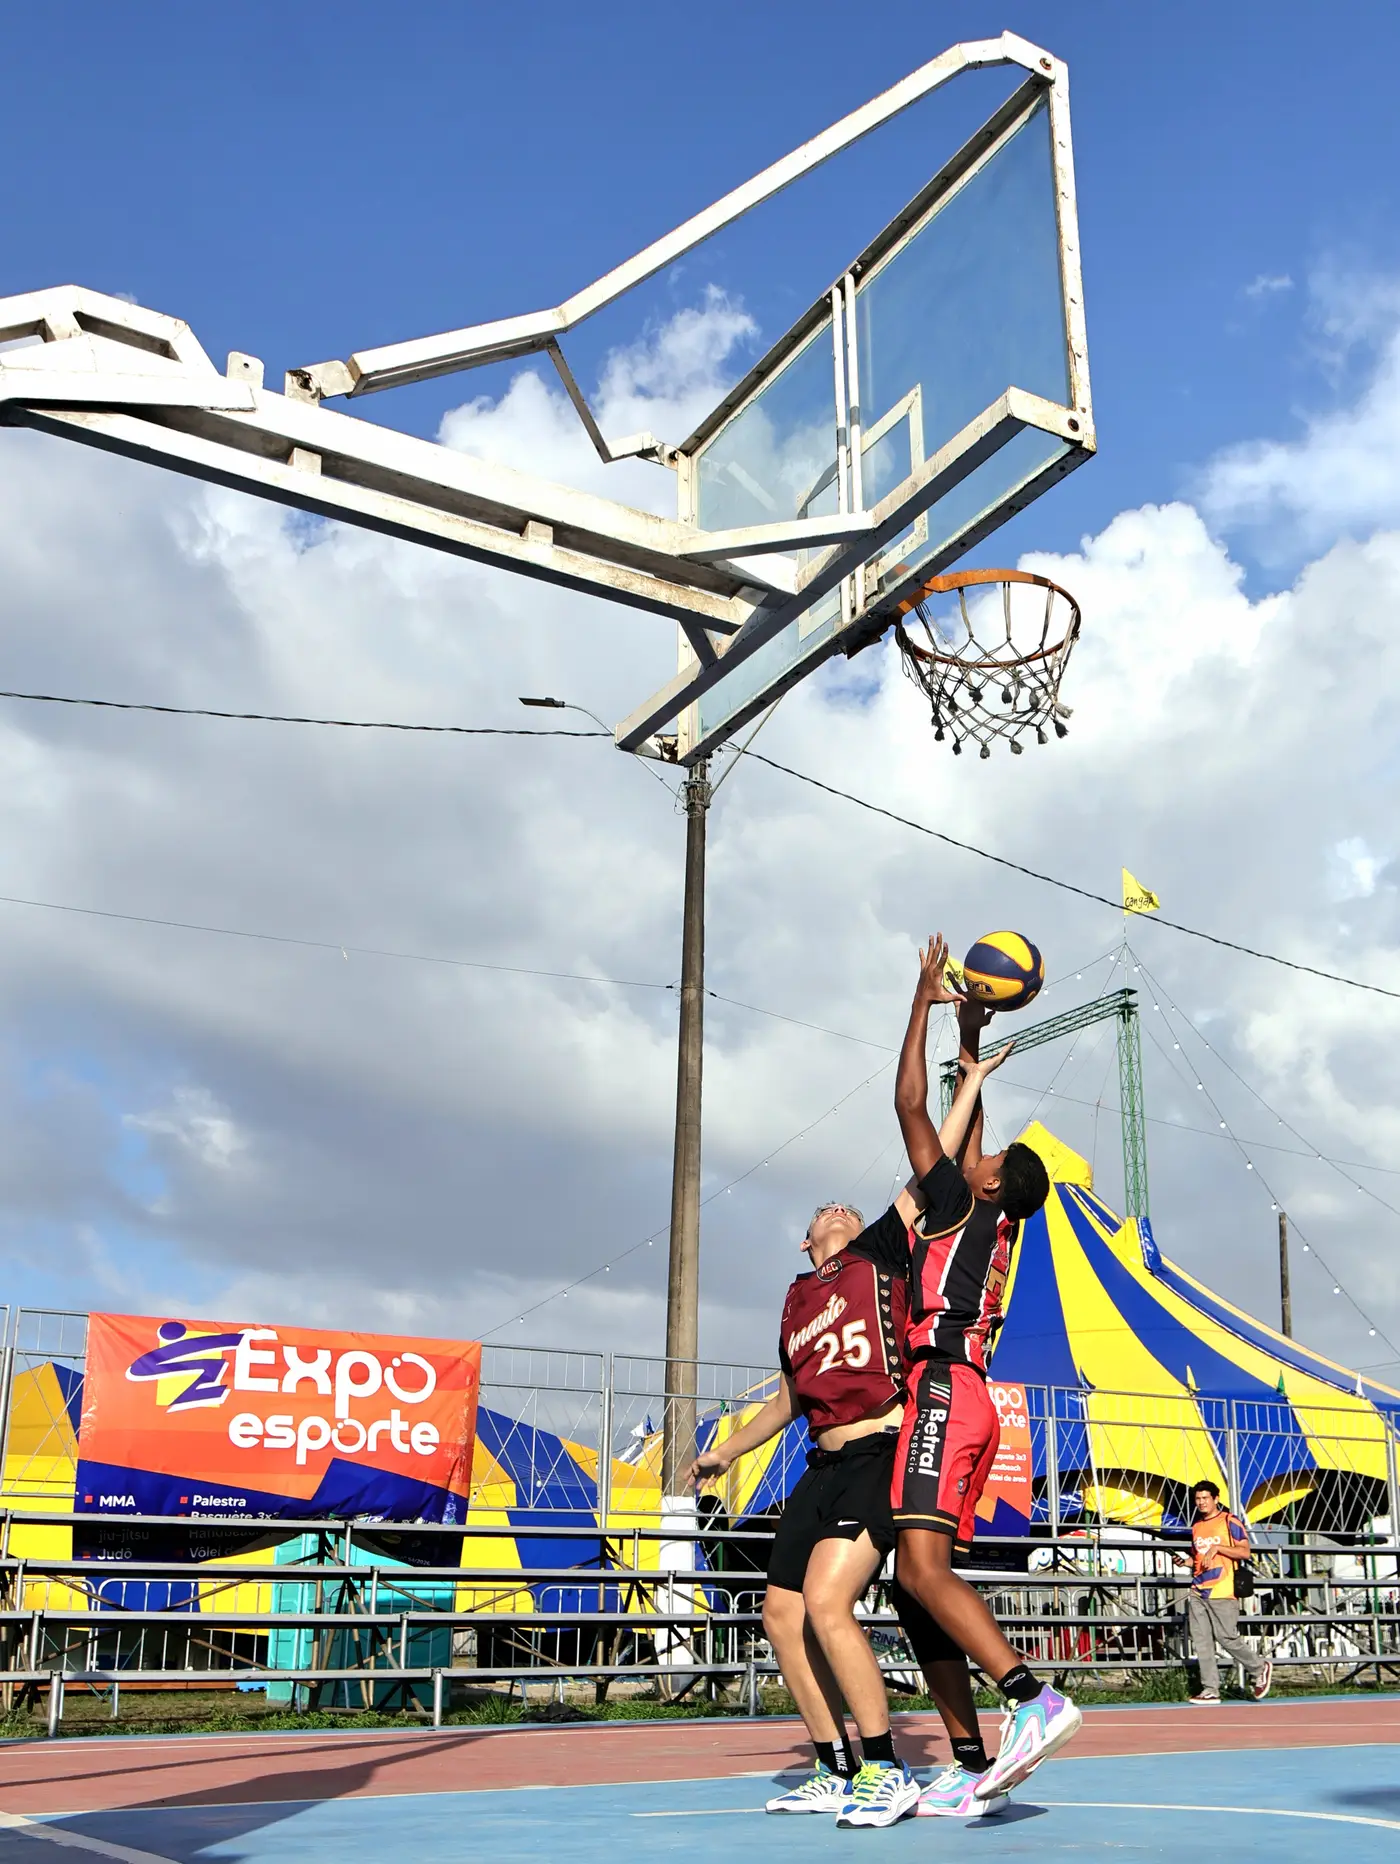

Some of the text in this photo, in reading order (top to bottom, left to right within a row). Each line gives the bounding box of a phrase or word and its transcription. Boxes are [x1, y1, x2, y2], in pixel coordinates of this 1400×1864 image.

[821, 1261, 839, 1277] AEC
[813, 1318, 872, 1377] 25
[233, 1328, 437, 1419] Expo
[988, 1386, 1023, 1415] po
[918, 1409, 930, 1424] faz
[998, 1410, 1027, 1428] orte
[228, 1409, 440, 1465] esporte
[918, 1408, 948, 1478] Betral
[1004, 1474, 1012, 1482] de
[99, 1495, 136, 1508] MMA
[192, 1494, 247, 1508] Palestra
[98, 1528, 150, 1544] jiu-jitsu
[189, 1545, 221, 1559] Vôlei
[834, 1751, 848, 1772] NIKE
